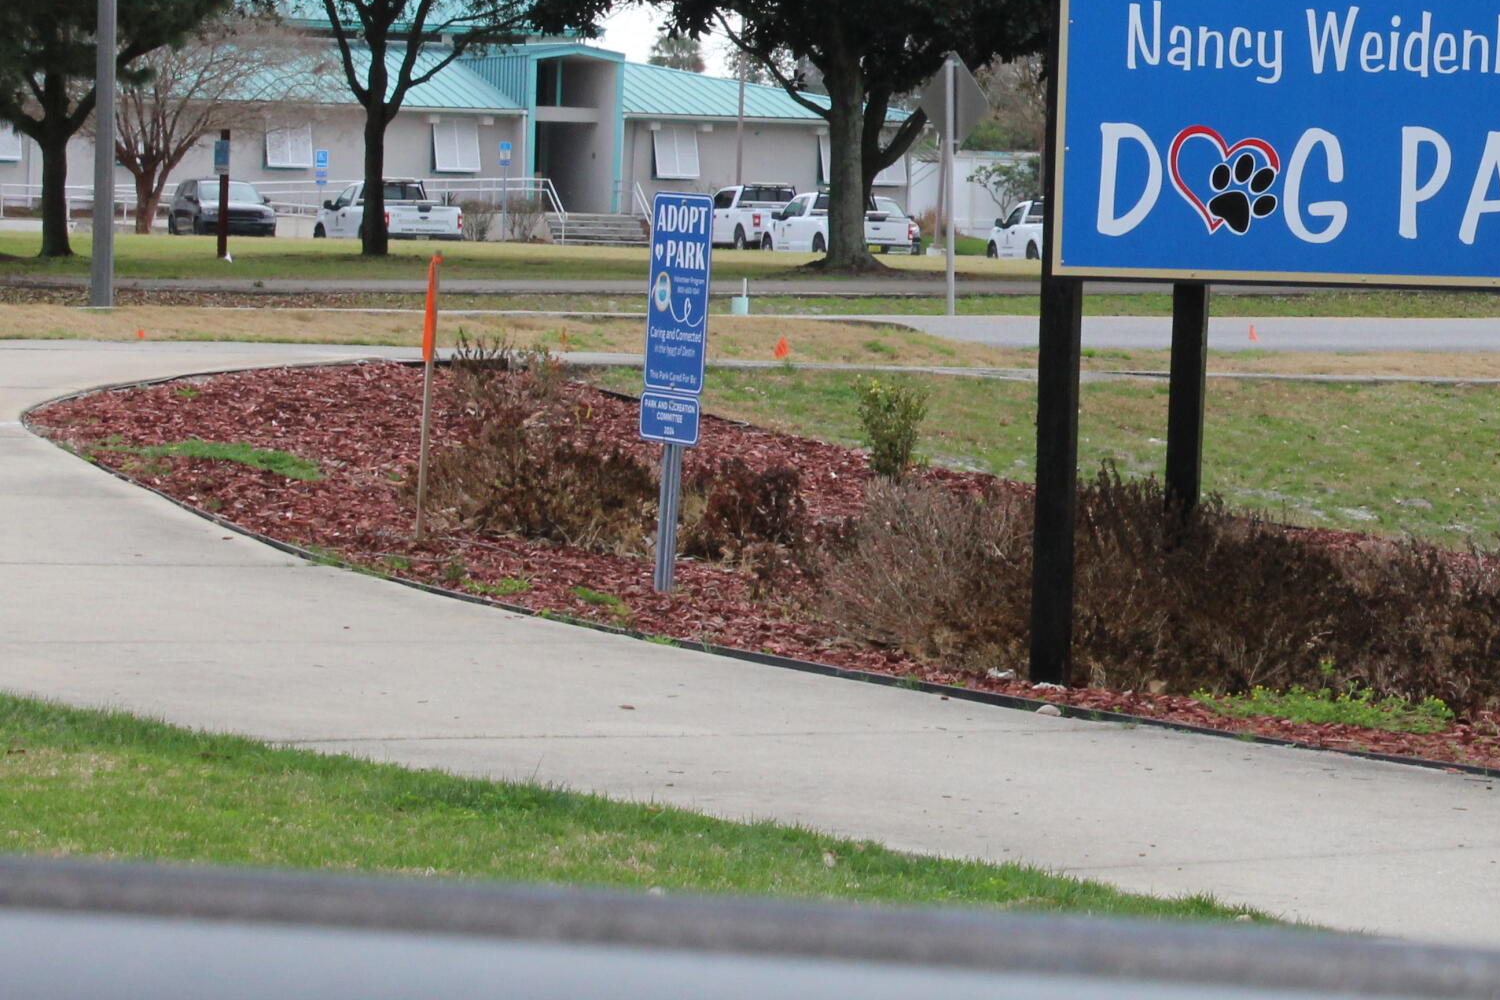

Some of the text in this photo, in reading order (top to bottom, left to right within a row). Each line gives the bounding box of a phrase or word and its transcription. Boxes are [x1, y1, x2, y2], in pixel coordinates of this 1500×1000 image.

[1127, 0, 1283, 83] Nancy
[657, 204, 708, 234] ADOPT
[665, 240, 706, 270] PARK
[650, 326, 702, 343] Caring and Connected
[659, 370, 669, 380] Park
[644, 399, 657, 408] PARK
[657, 400, 668, 410] AND
[656, 411, 683, 424] COMMITTEE
